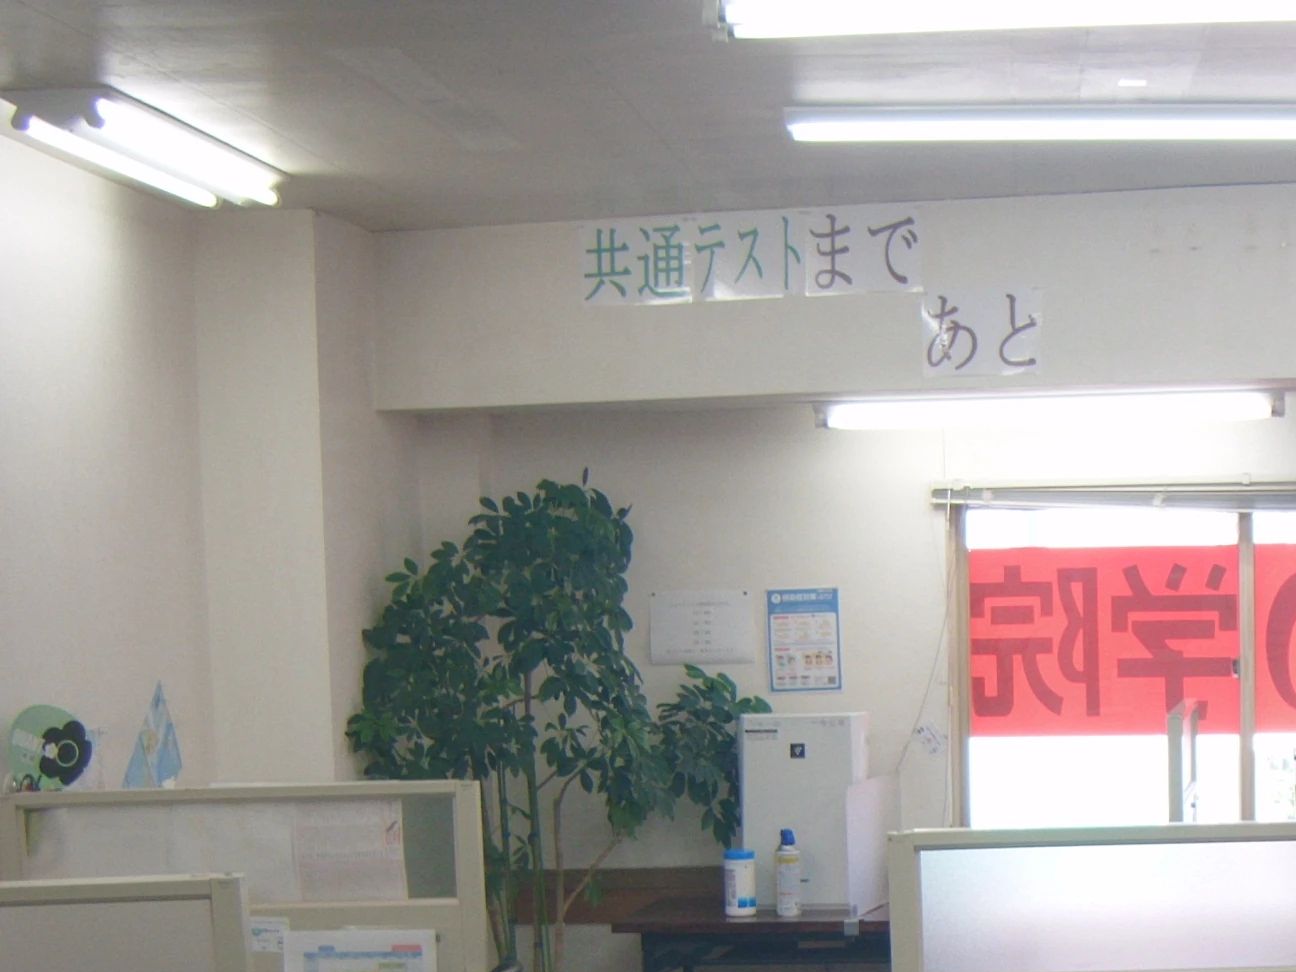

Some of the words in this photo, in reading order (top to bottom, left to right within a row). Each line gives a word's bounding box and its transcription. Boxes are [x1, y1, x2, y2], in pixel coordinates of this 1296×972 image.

[583, 213, 919, 301] 共通テストまで
[927, 293, 1037, 370] あと
